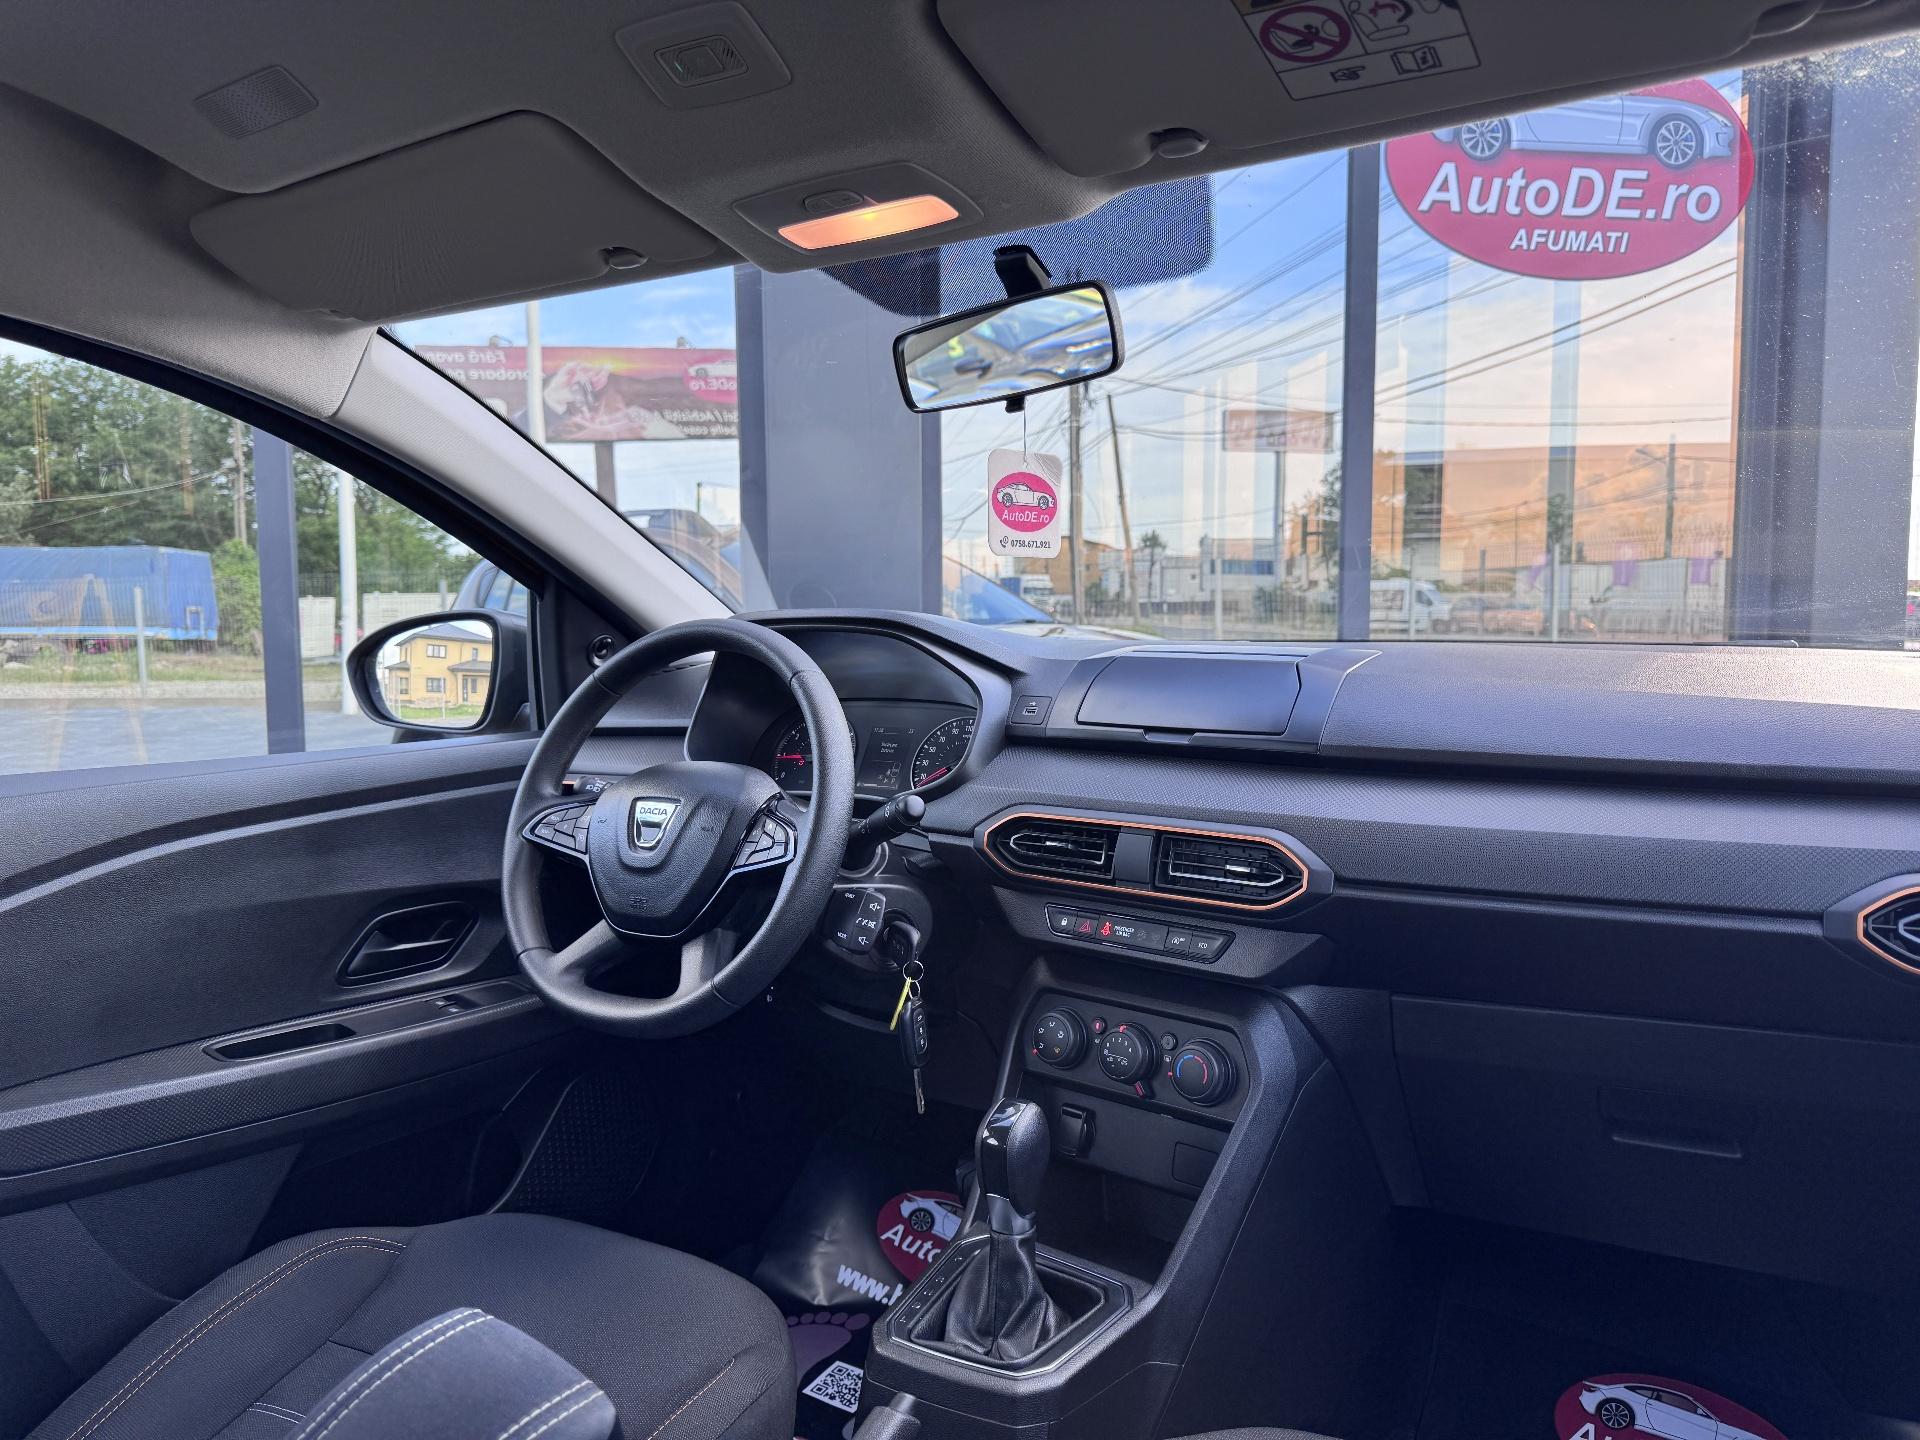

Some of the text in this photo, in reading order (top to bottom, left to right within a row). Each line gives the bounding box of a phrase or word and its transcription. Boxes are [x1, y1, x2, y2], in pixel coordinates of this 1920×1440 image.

[1418, 162, 1721, 223] AutoDE.ro
[1510, 228, 1630, 254] AFUMATI
[1002, 510, 1050, 523] AutoDE.ro
[1010, 539, 1051, 549] 0758.671.921
[639, 806, 668, 816] DACIA
